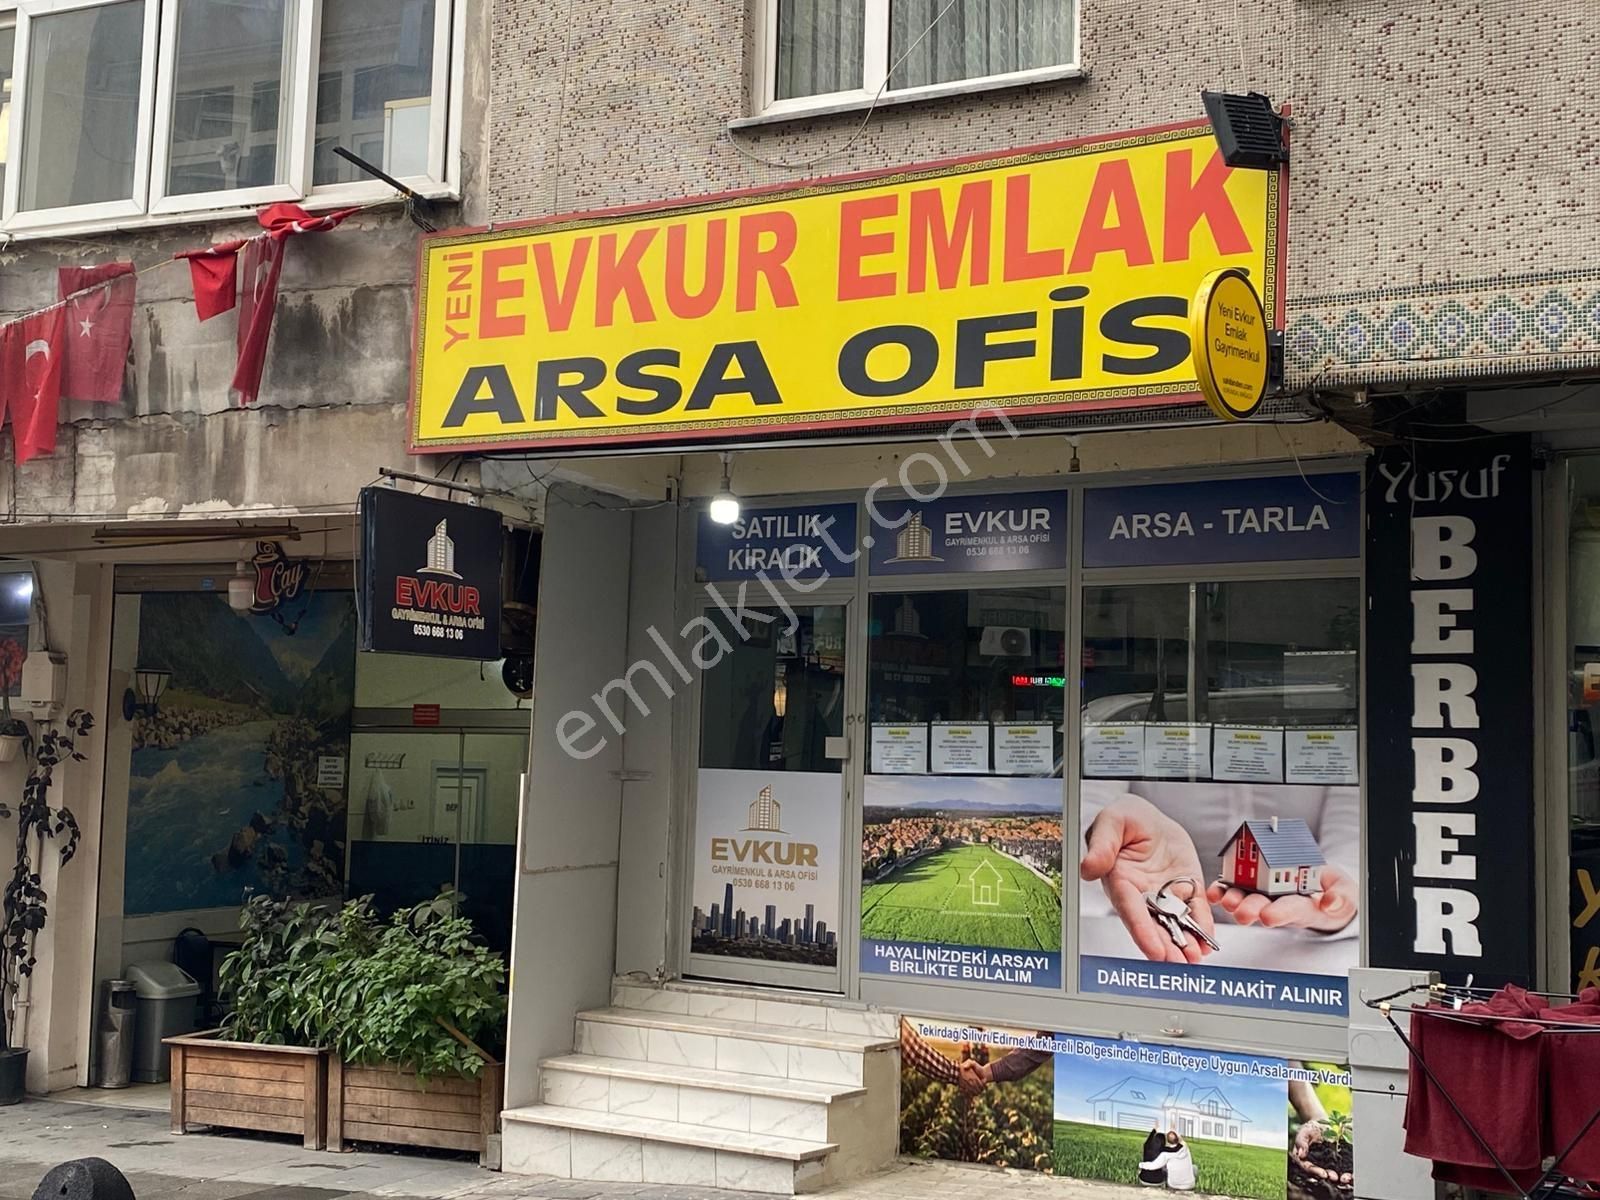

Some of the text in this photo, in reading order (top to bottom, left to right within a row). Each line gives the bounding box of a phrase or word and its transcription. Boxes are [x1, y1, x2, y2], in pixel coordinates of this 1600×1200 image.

[479, 147, 1254, 340] EVKUR EMLAK
[443, 251, 473, 352] YENİ
[1217, 302, 1256, 326] Yeni Evkur
[1224, 322, 1248, 342] Emlak
[440, 267, 1250, 429] ARSA OFİS
[1378, 454, 1512, 503] Yusuf
[731, 513, 821, 540] SATILIK
[945, 507, 1051, 535] EVKUR
[1108, 504, 1330, 540] ARSA - TARLA
[1007, 535, 1028, 545] ARSA
[728, 543, 823, 571] KİRALIK
[396, 576, 480, 615] EVKUR
[413, 624, 464, 640] 0530 668 13 06
[1410, 515, 1483, 958] BERBER
[711, 837, 819, 868] EVKUR
[711, 864, 765, 878] GAYRİMENKUL
[767, 868, 773, 878] &
[774, 869, 796, 880] ARSA
[732, 878, 795, 891] 0530 668 13 06
[875, 944, 1049, 971] HAYALİNİZDEKİ ARSAYI
[889, 960, 1033, 984] BİRLİKTE BULALIM
[1097, 967, 1343, 1007] DAİRELERİNİZ NAKİT ALINIR
[1076, 1040, 1137, 1062] Bölgesinde
[1139, 1047, 1160, 1063] Her
[1162, 1050, 1208, 1070] Bütçeye
[1210, 1058, 1249, 1076] Uygun
[1251, 1062, 1319, 1082] Arsalarımız
